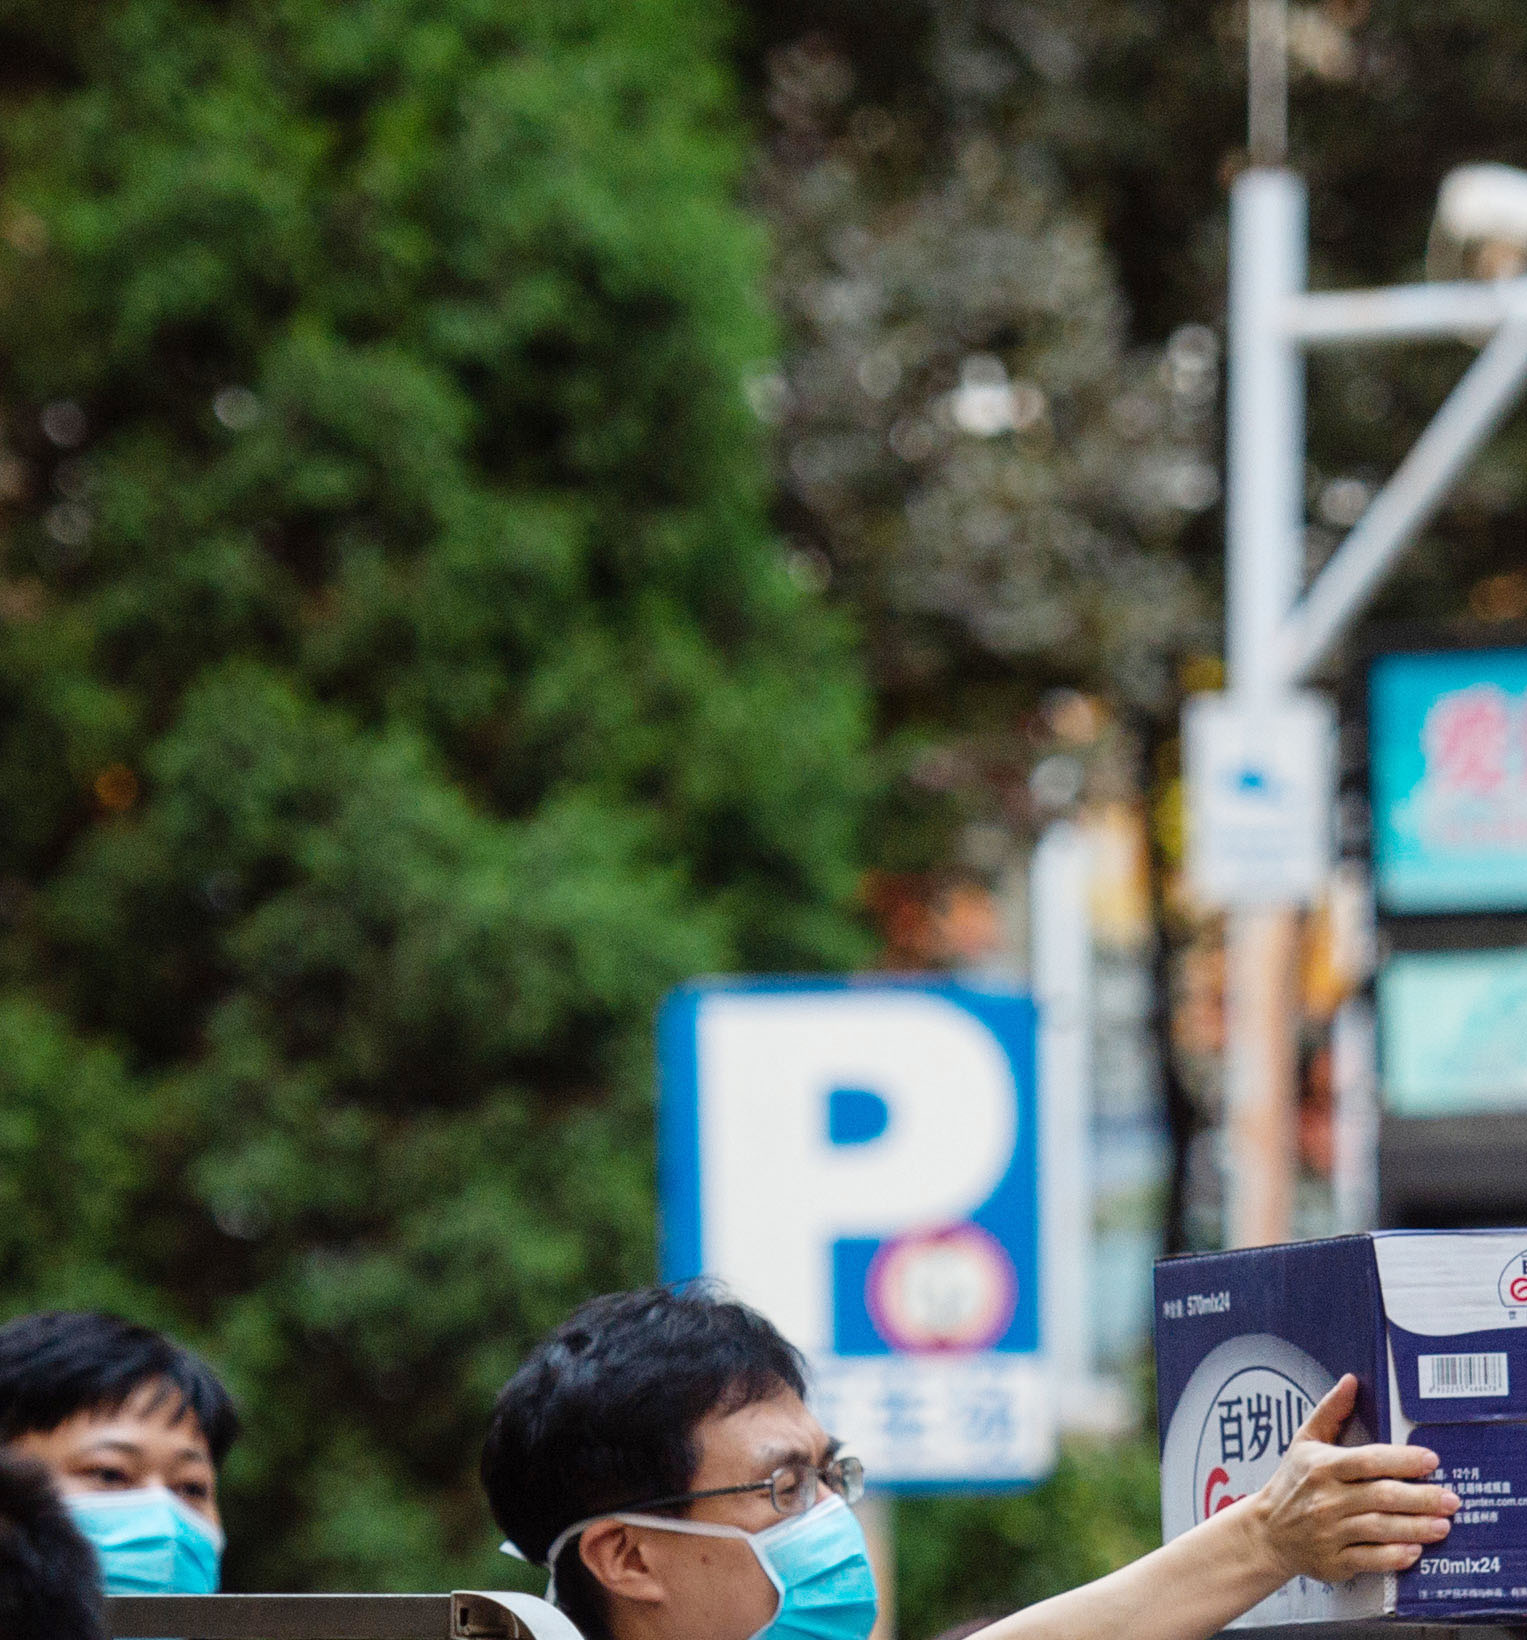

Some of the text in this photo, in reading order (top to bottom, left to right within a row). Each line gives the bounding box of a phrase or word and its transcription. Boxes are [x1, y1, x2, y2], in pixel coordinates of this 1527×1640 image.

[694, 992, 1021, 1352] P
[1218, 1389, 1306, 1465] 百岁山
